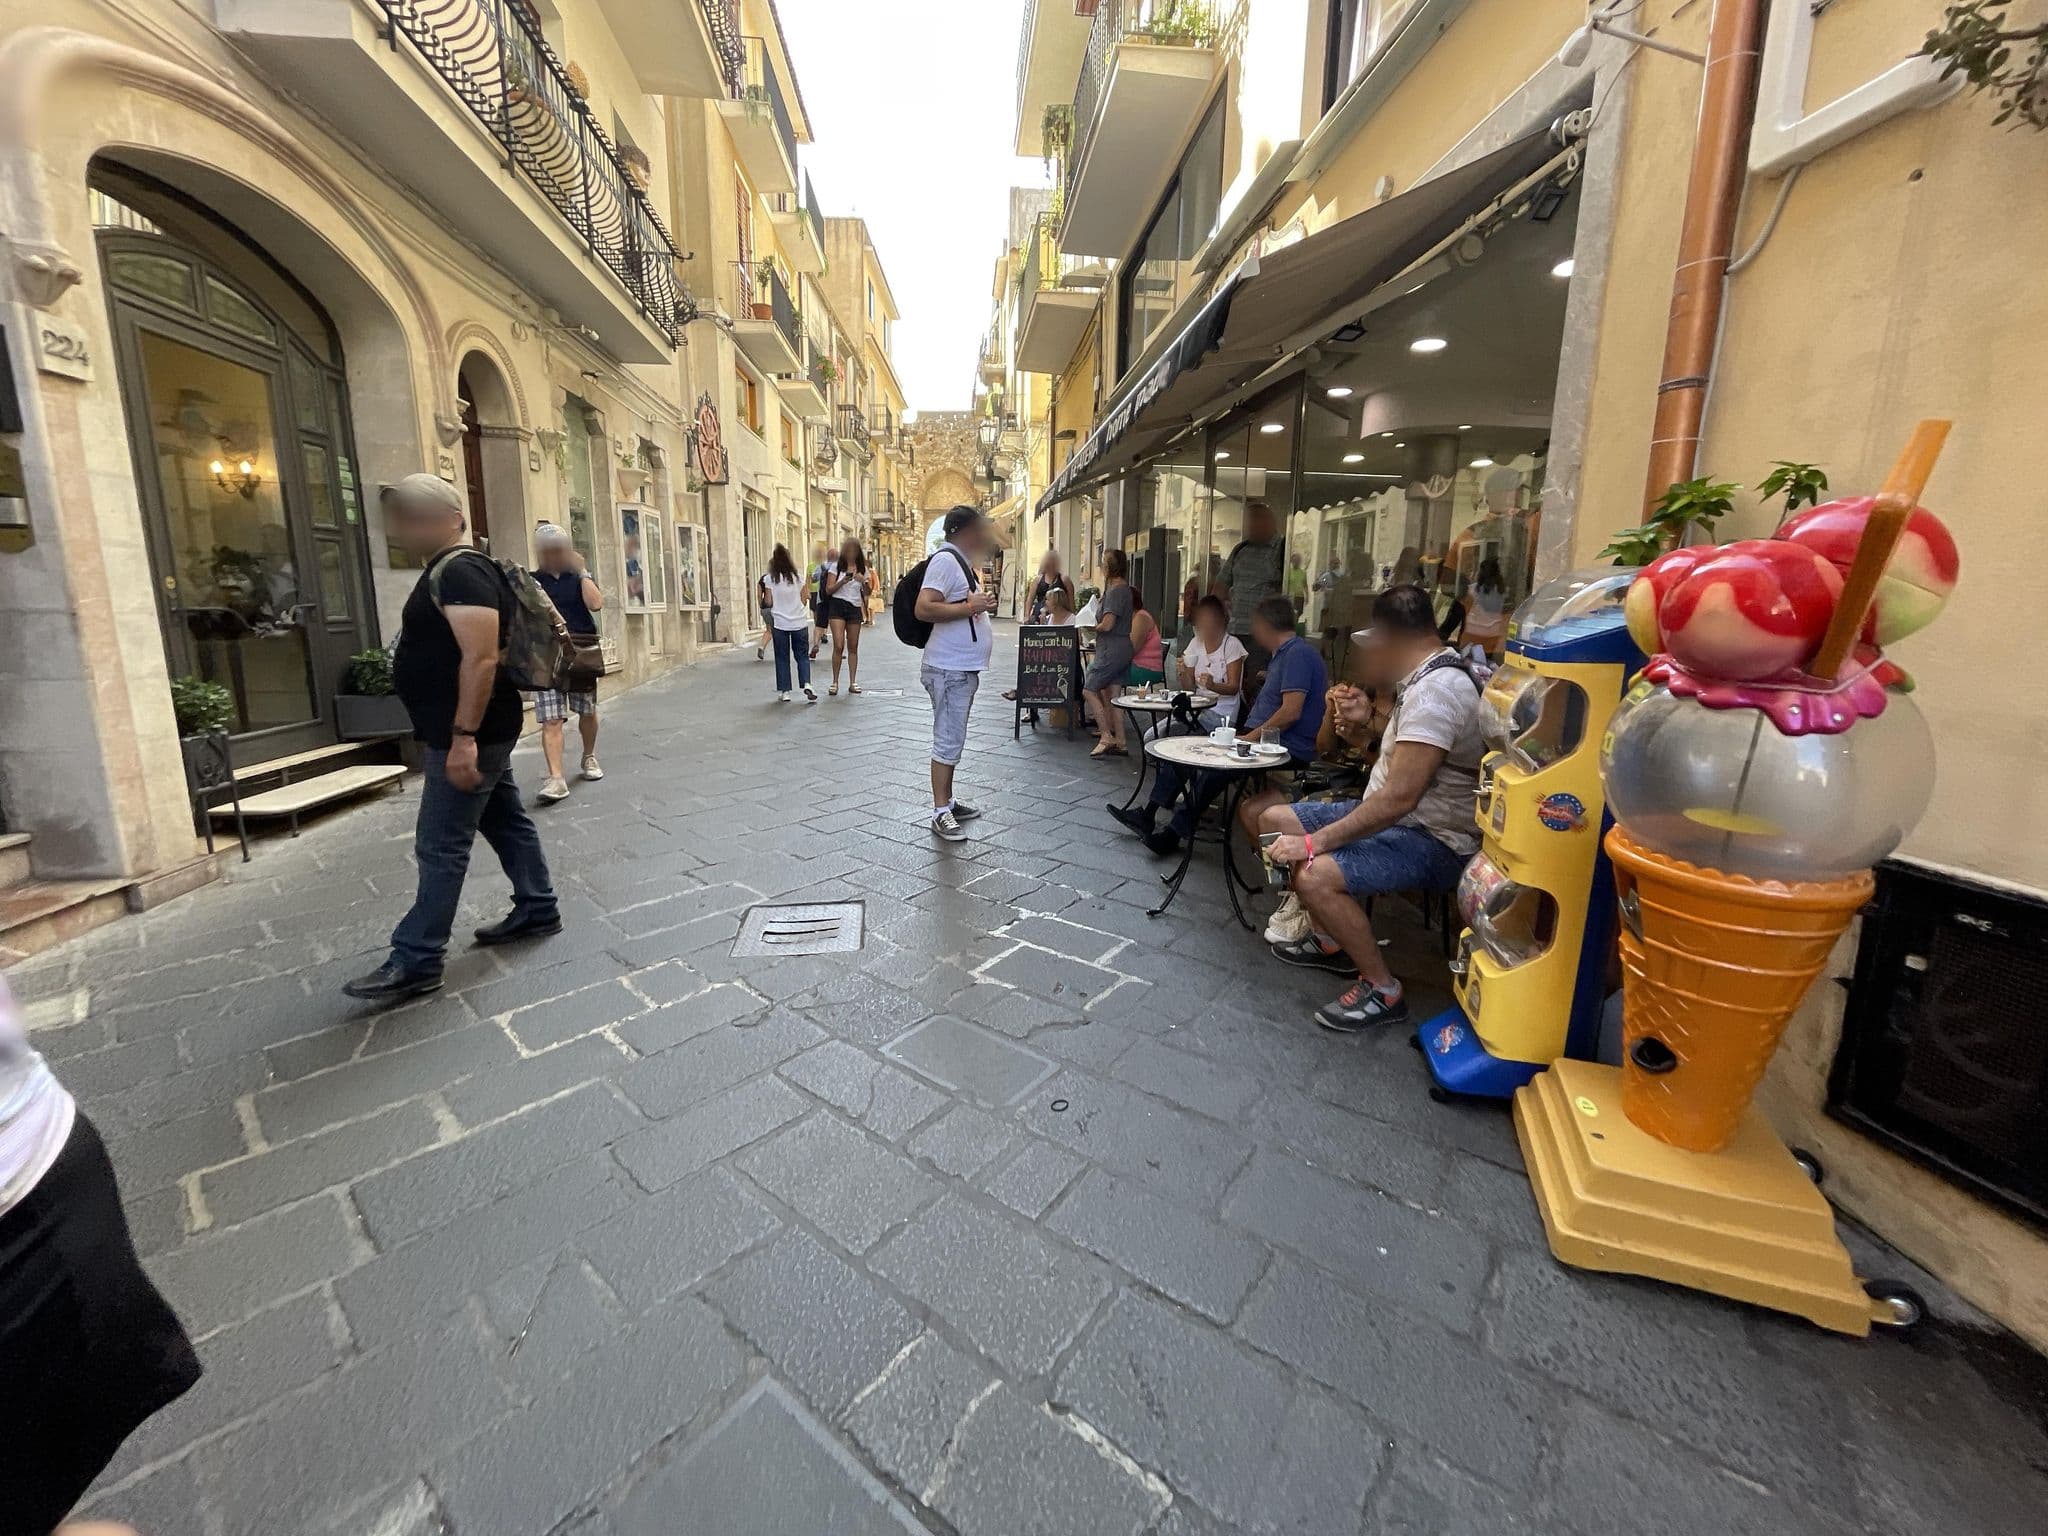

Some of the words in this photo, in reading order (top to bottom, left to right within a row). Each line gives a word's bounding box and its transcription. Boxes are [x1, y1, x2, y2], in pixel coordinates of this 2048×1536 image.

[41, 329, 90, 366] 224
[1023, 637, 1044, 648] Money
[1061, 636, 1073, 649] buy
